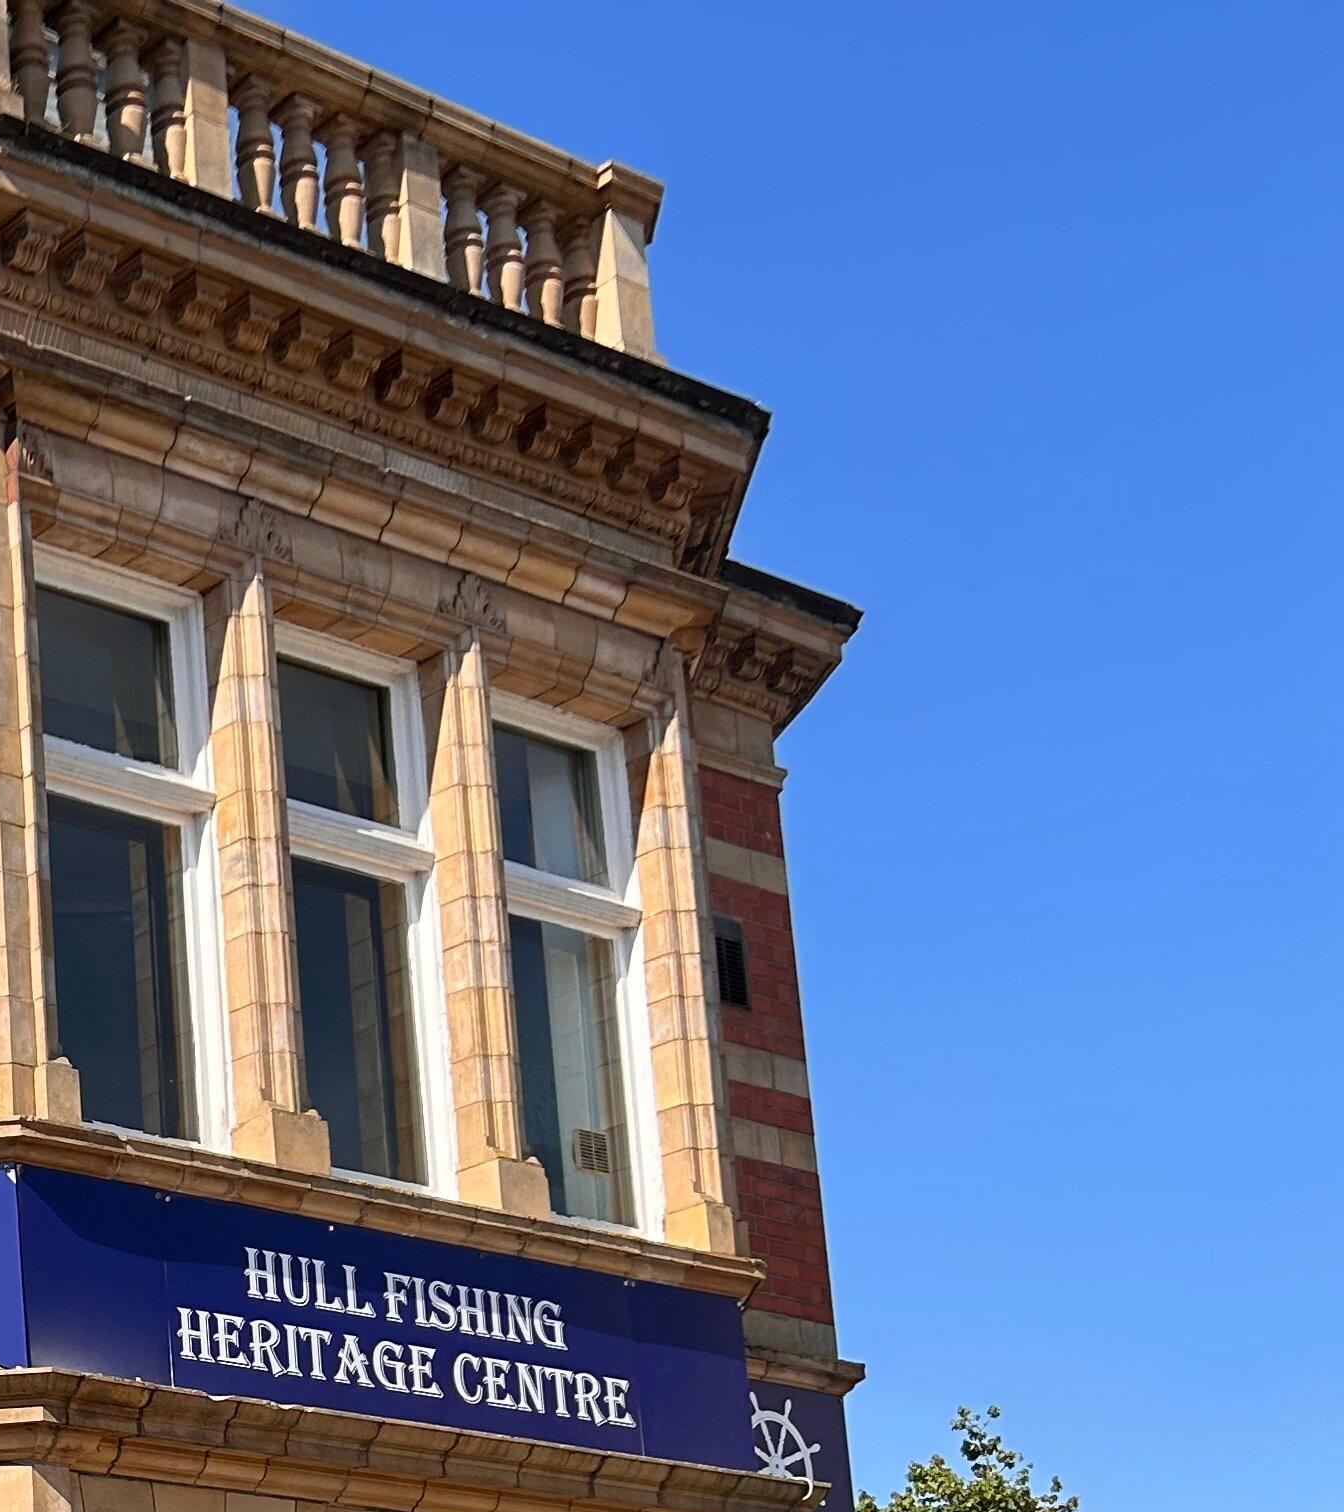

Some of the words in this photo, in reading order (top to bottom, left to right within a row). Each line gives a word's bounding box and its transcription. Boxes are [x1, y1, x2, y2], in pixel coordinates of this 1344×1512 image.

[243, 1246, 376, 1319] HULL
[382, 1271, 569, 1351] FISHING
[176, 1306, 444, 1398] HERITAGE
[452, 1352, 638, 1429] CENTRE
